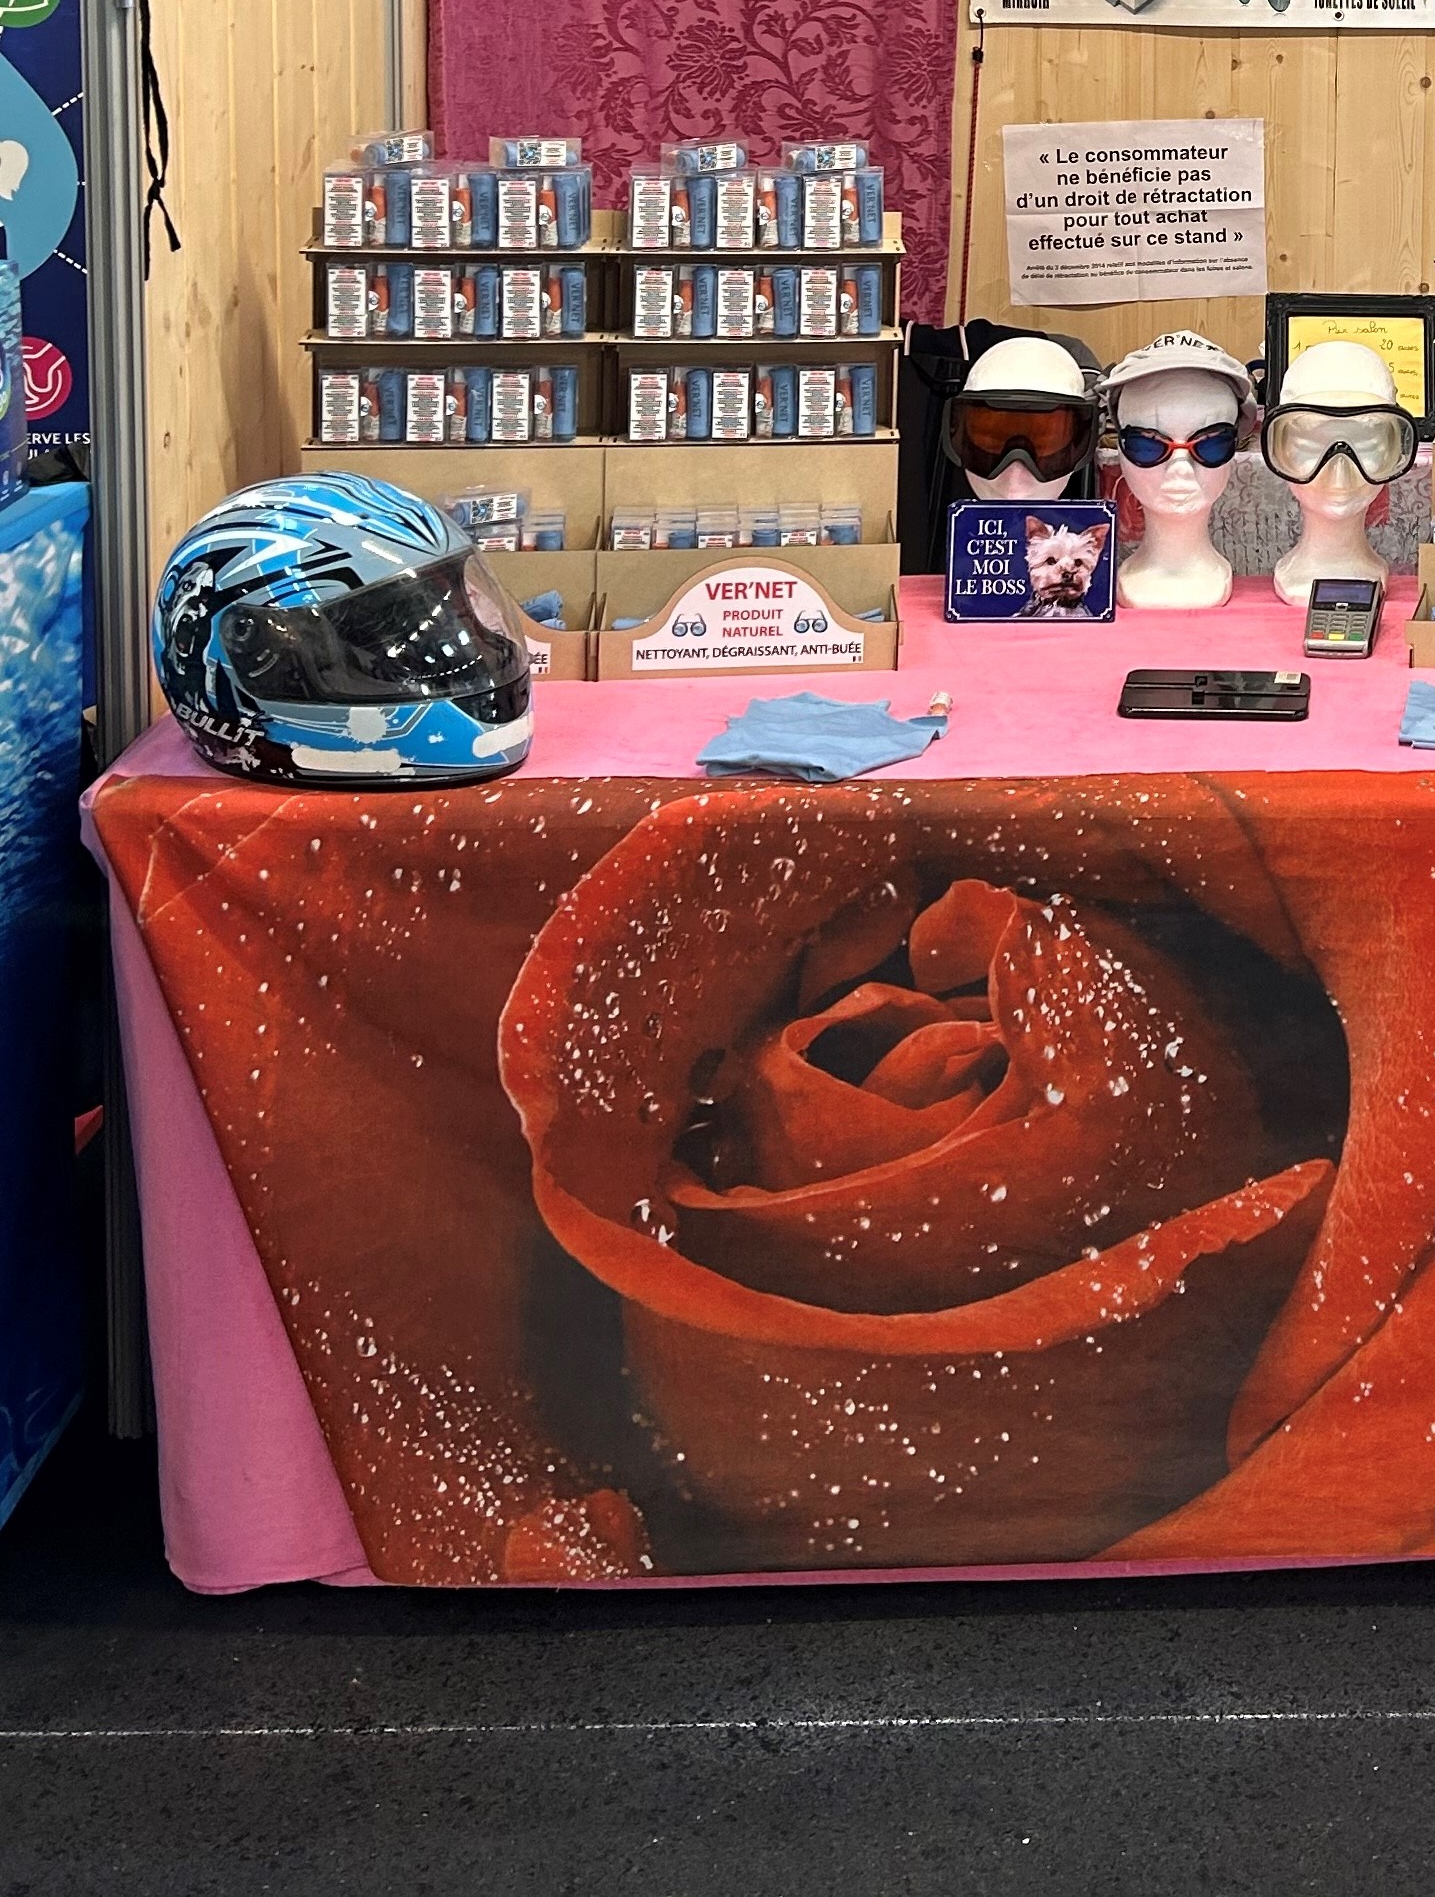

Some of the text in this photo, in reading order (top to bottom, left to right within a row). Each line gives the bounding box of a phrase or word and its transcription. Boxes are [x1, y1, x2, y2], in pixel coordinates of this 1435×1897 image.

[1056, 149, 1079, 164] Le
[1085, 145, 1228, 163] consommateur
[1057, 167, 1211, 186] ne bénéficie pas
[1016, 186, 1252, 209] d'un droit de rétractation
[1064, 210, 1208, 231] pour tout achat
[1028, 232, 1105, 251] effectué
[1110, 233, 1141, 248] sur
[1146, 233, 1168, 246] ce
[1174, 228, 1227, 244] stand
[1354, 320, 1388, 334] salon
[1379, 338, 1394, 350] 20
[978, 519, 1008, 537] ICI,
[967, 539, 1018, 555] C'EST
[972, 559, 1010, 575] MOI
[705, 581, 798, 600] VER'NET
[955, 579, 1026, 595] LE BOSS
[723, 608, 783, 621] PRODUIT
[722, 626, 784, 638] NATUREL
[636, 641, 862, 662] NETTOYANT, DÉGRAISSANT, ANTI-BUÉE
[176, 702, 265, 746] BULLIT
